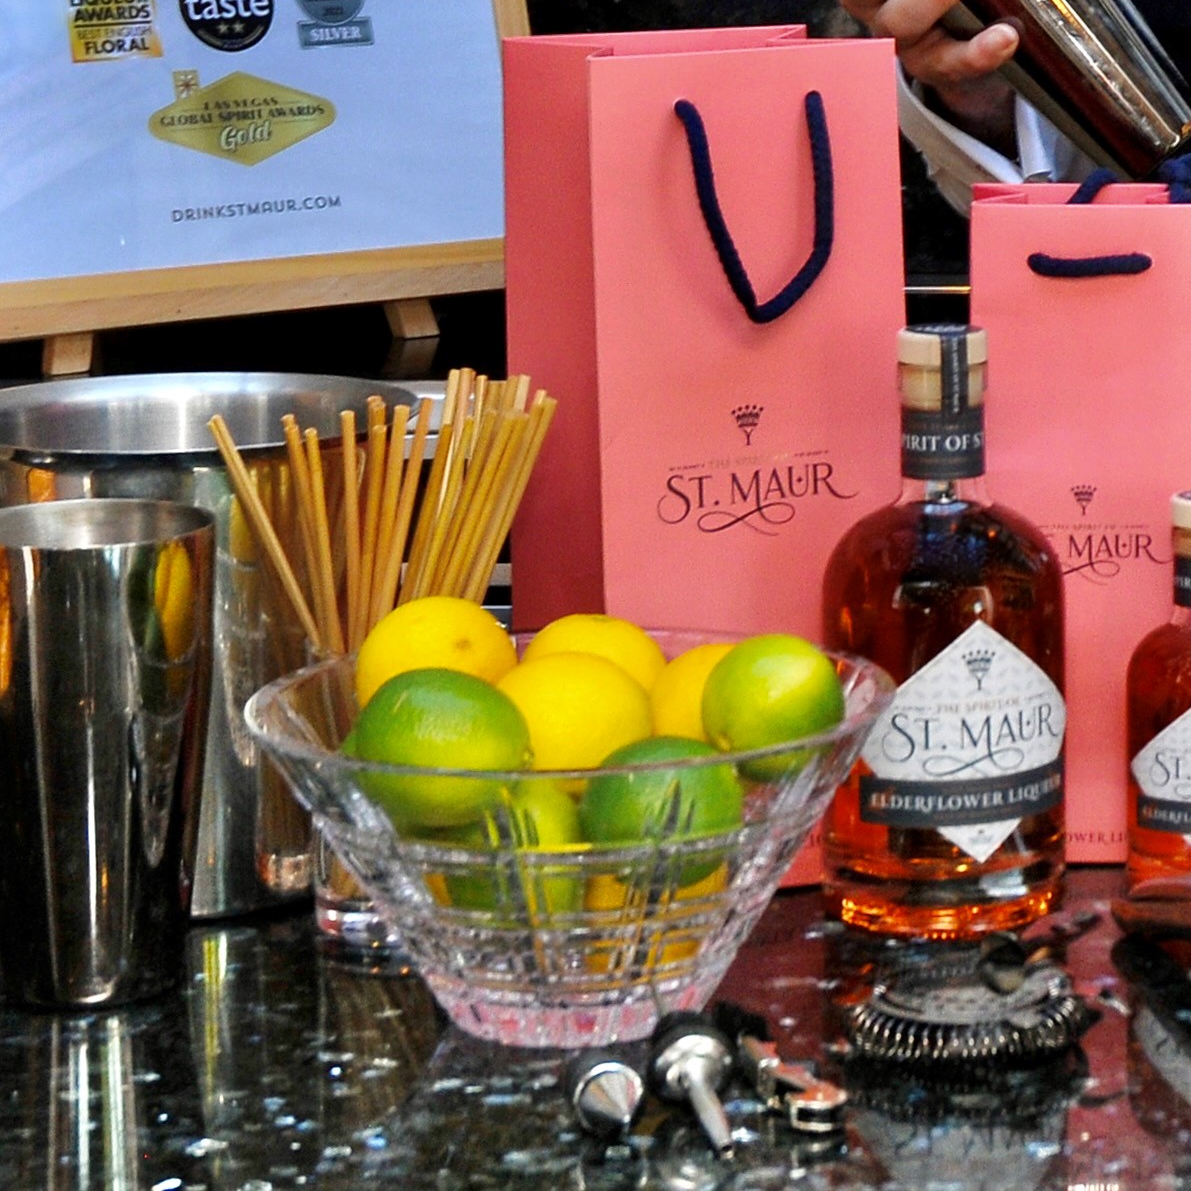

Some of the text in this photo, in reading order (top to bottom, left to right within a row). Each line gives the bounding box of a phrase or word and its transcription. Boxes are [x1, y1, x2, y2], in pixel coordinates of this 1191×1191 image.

[74, 5, 150, 23] AWARDS
[309, 25, 362, 43] SILVER
[84, 39, 150, 56] FLORAL
[160, 113, 213, 127] GLOBAL
[220, 120, 273, 153] Gold
[171, 195, 342, 224] DRINKSTMAUR.COM
[944, 433, 971, 452] OF
[657, 462, 860, 524] ST. MAUR
[1065, 533, 1172, 577] MAUR
[882, 702, 1060, 766] ST. MAUR
[870, 789, 1004, 814] ELDERFLOWER
